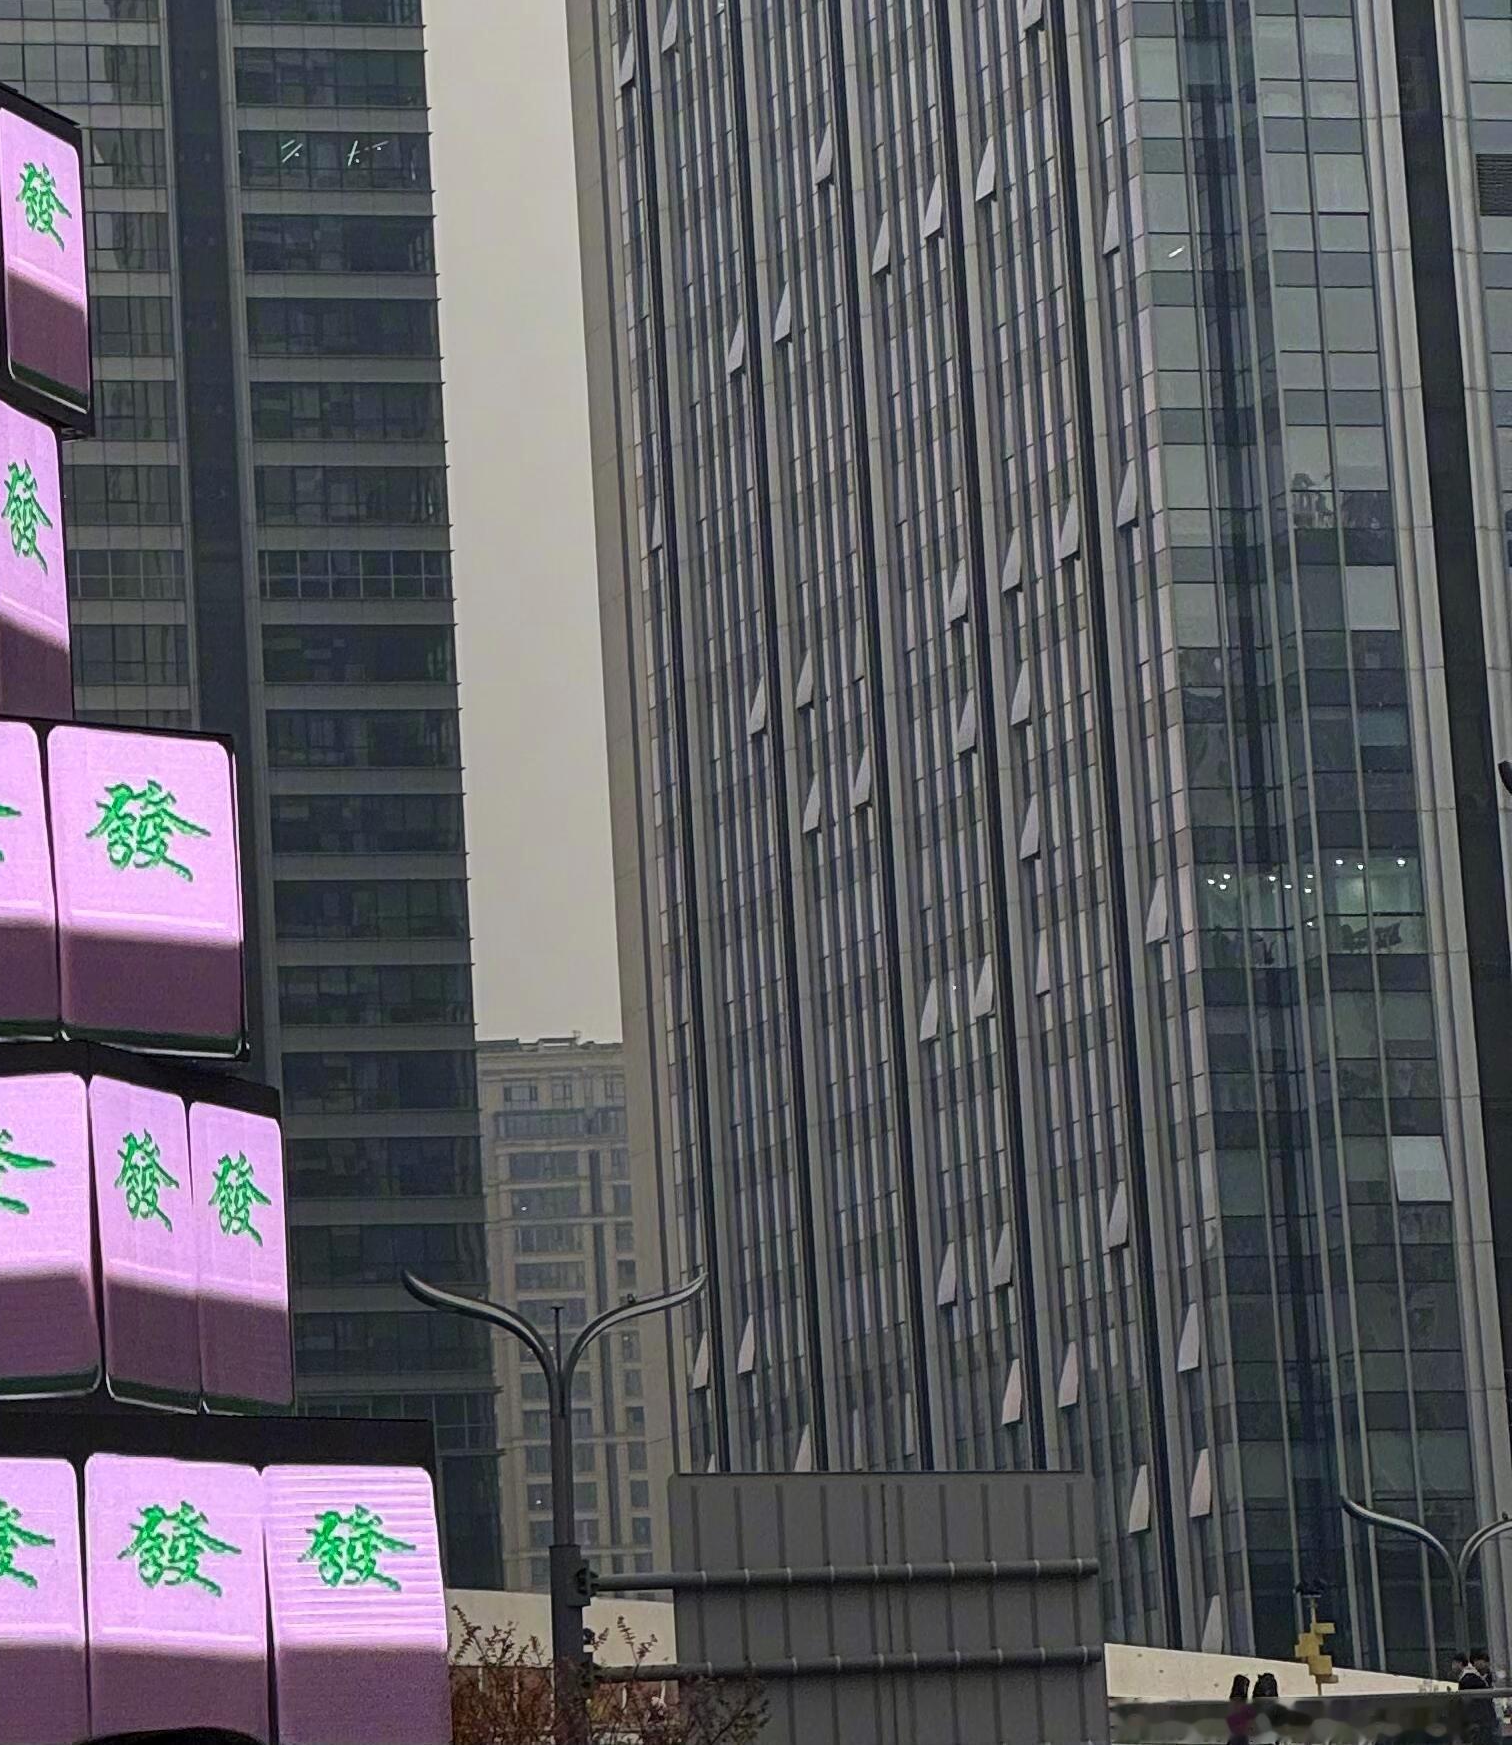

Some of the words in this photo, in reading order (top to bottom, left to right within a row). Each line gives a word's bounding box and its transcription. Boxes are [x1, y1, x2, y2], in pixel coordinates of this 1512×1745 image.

[86, 777, 211, 883] 發
[118, 1500, 242, 1600] 發
[300, 1503, 418, 1593] 發
